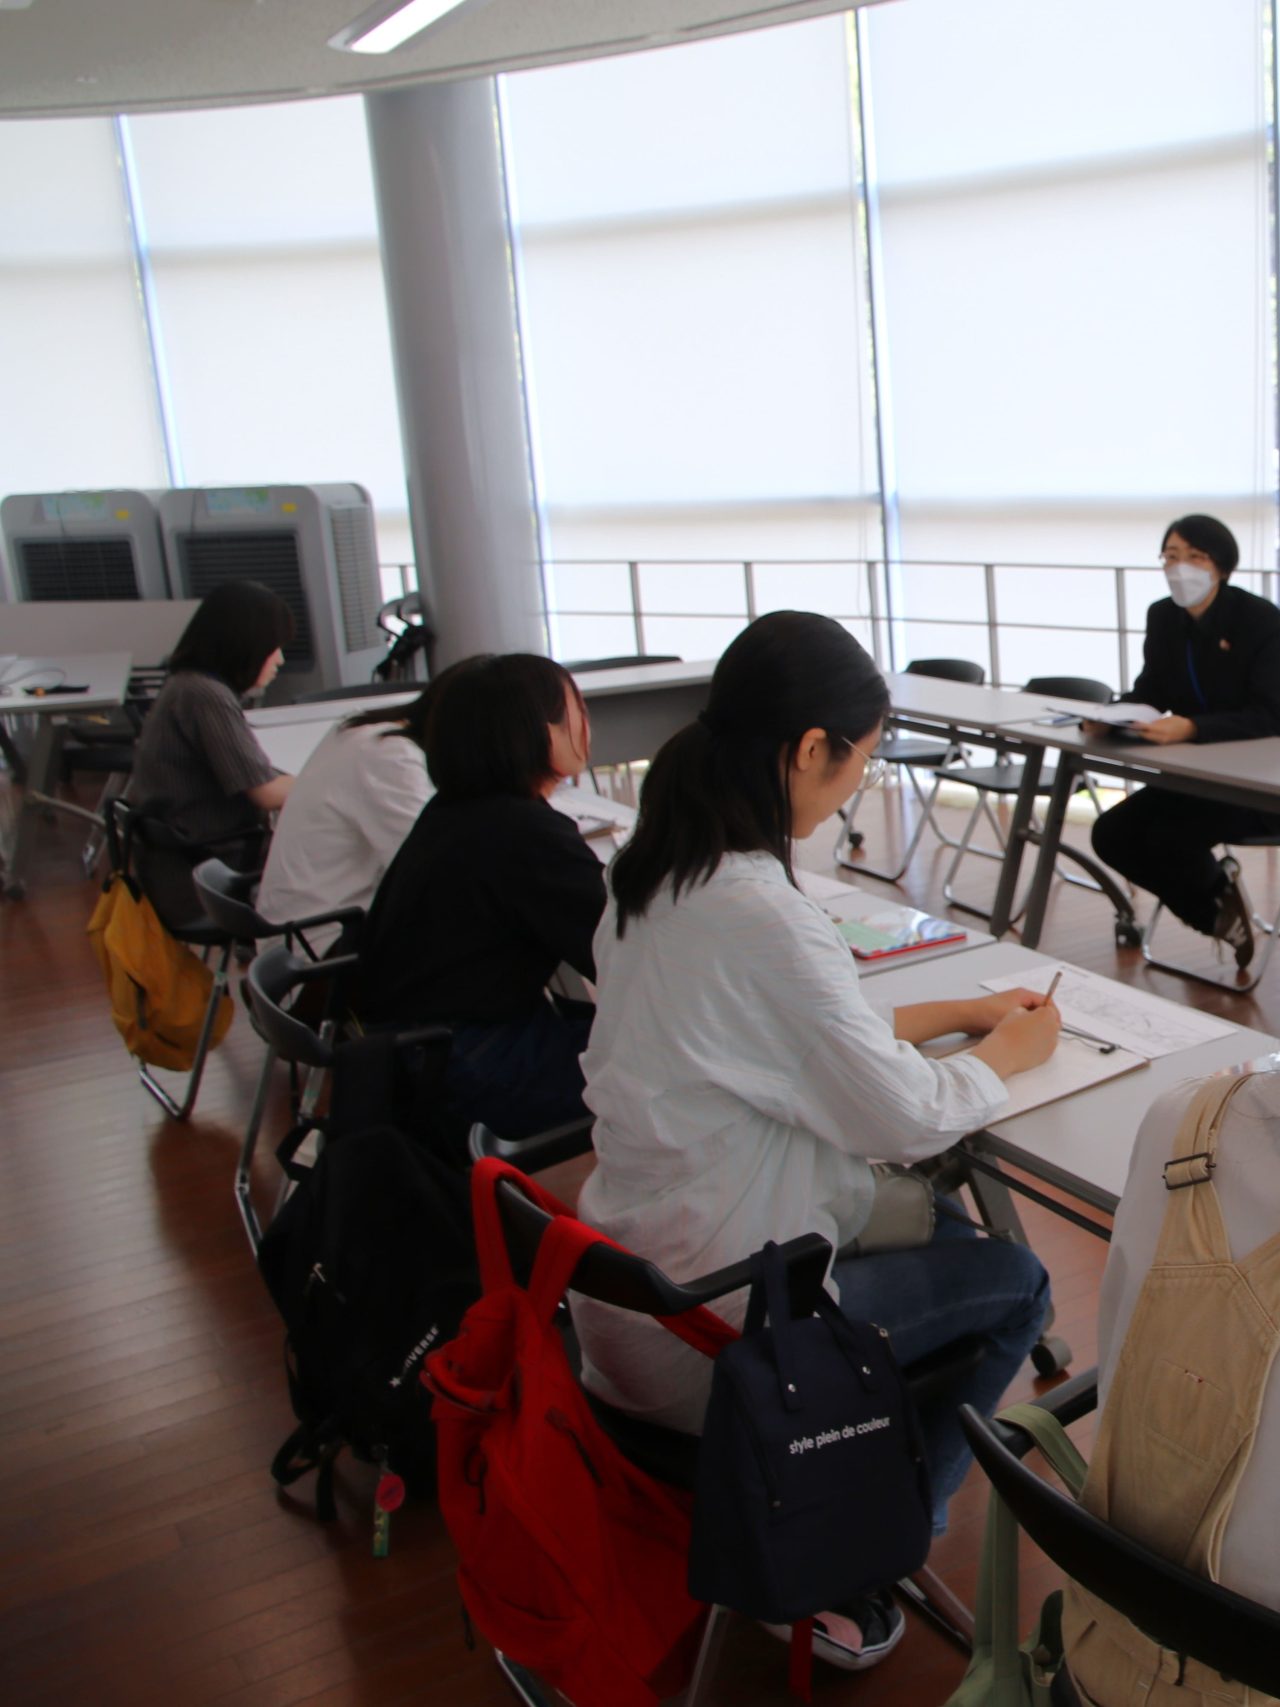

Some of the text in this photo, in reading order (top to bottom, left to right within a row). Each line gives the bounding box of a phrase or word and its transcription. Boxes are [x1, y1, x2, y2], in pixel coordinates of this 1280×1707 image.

[789, 1417, 890, 1455] style plein de couleur
